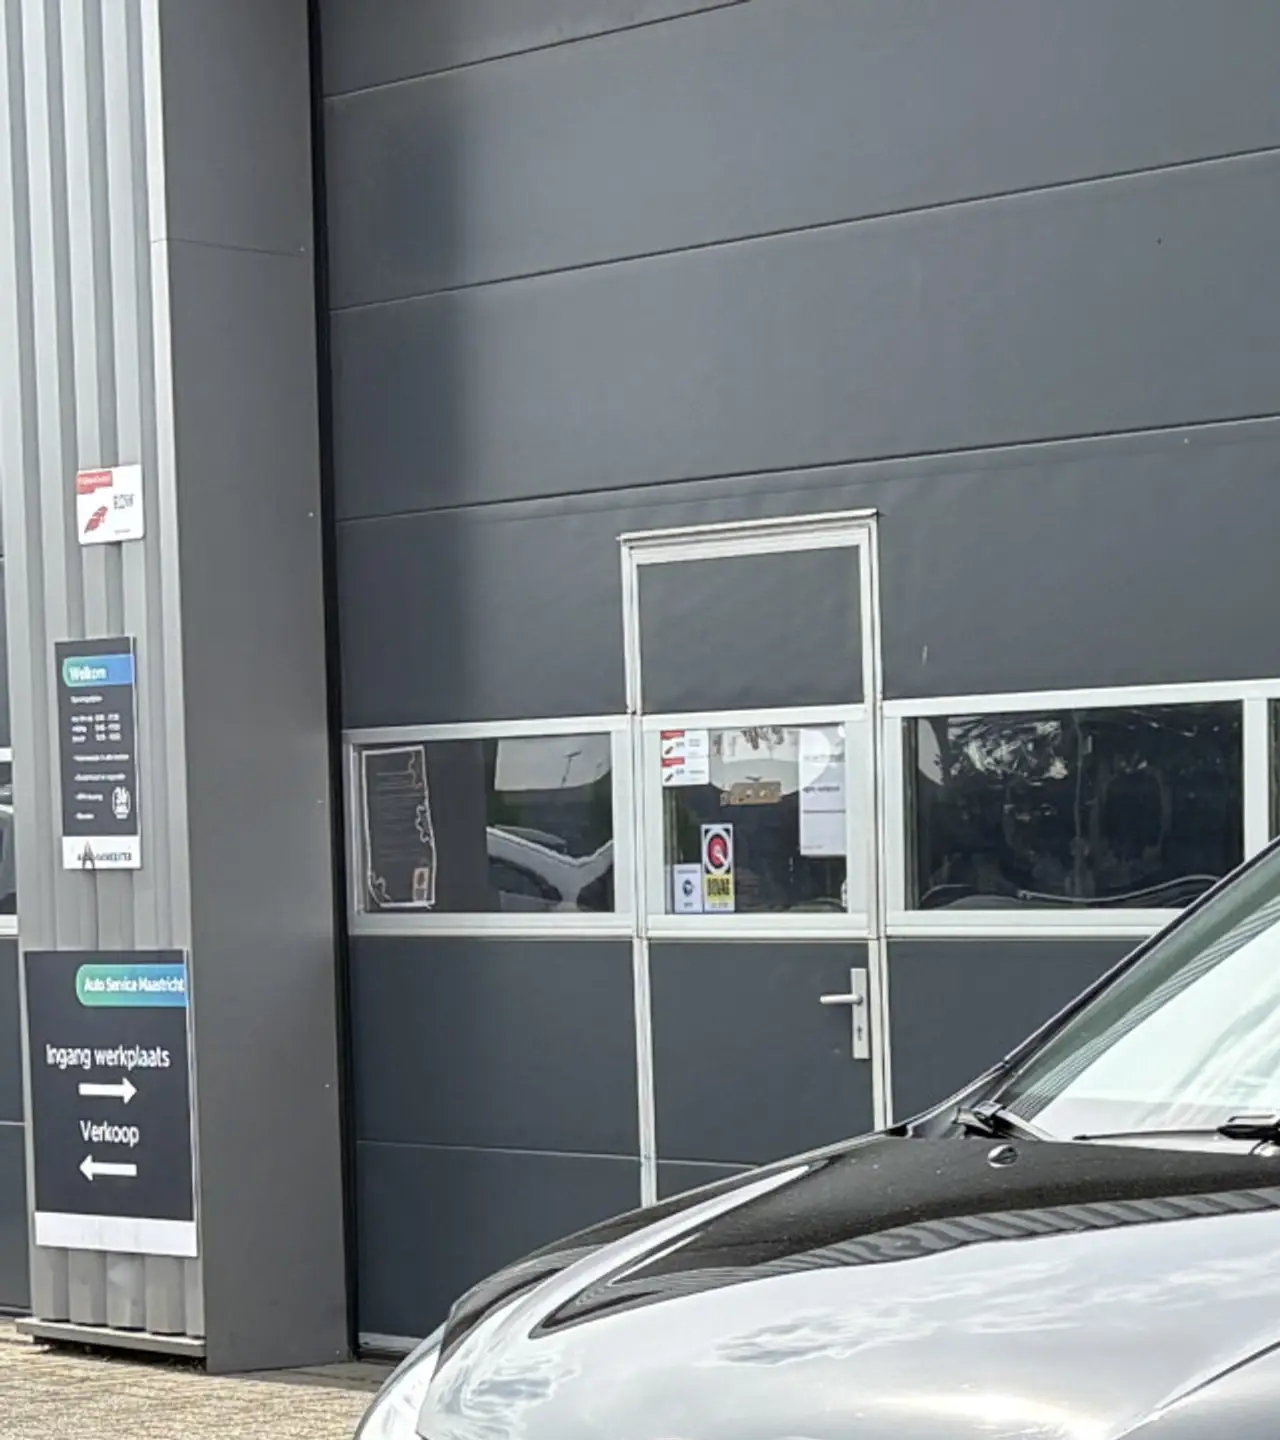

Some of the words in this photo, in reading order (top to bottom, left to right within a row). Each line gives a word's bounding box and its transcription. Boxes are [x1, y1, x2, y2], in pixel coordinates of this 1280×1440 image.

[70, 665, 107, 681] Welkom
[84, 977, 105, 992] Auto
[106, 976, 137, 992] Service
[138, 976, 185, 992] Maastricht
[46, 1043, 92, 1070] Ingang
[93, 1043, 171, 1072] werkplaats
[79, 1119, 140, 1149] Verkoop
